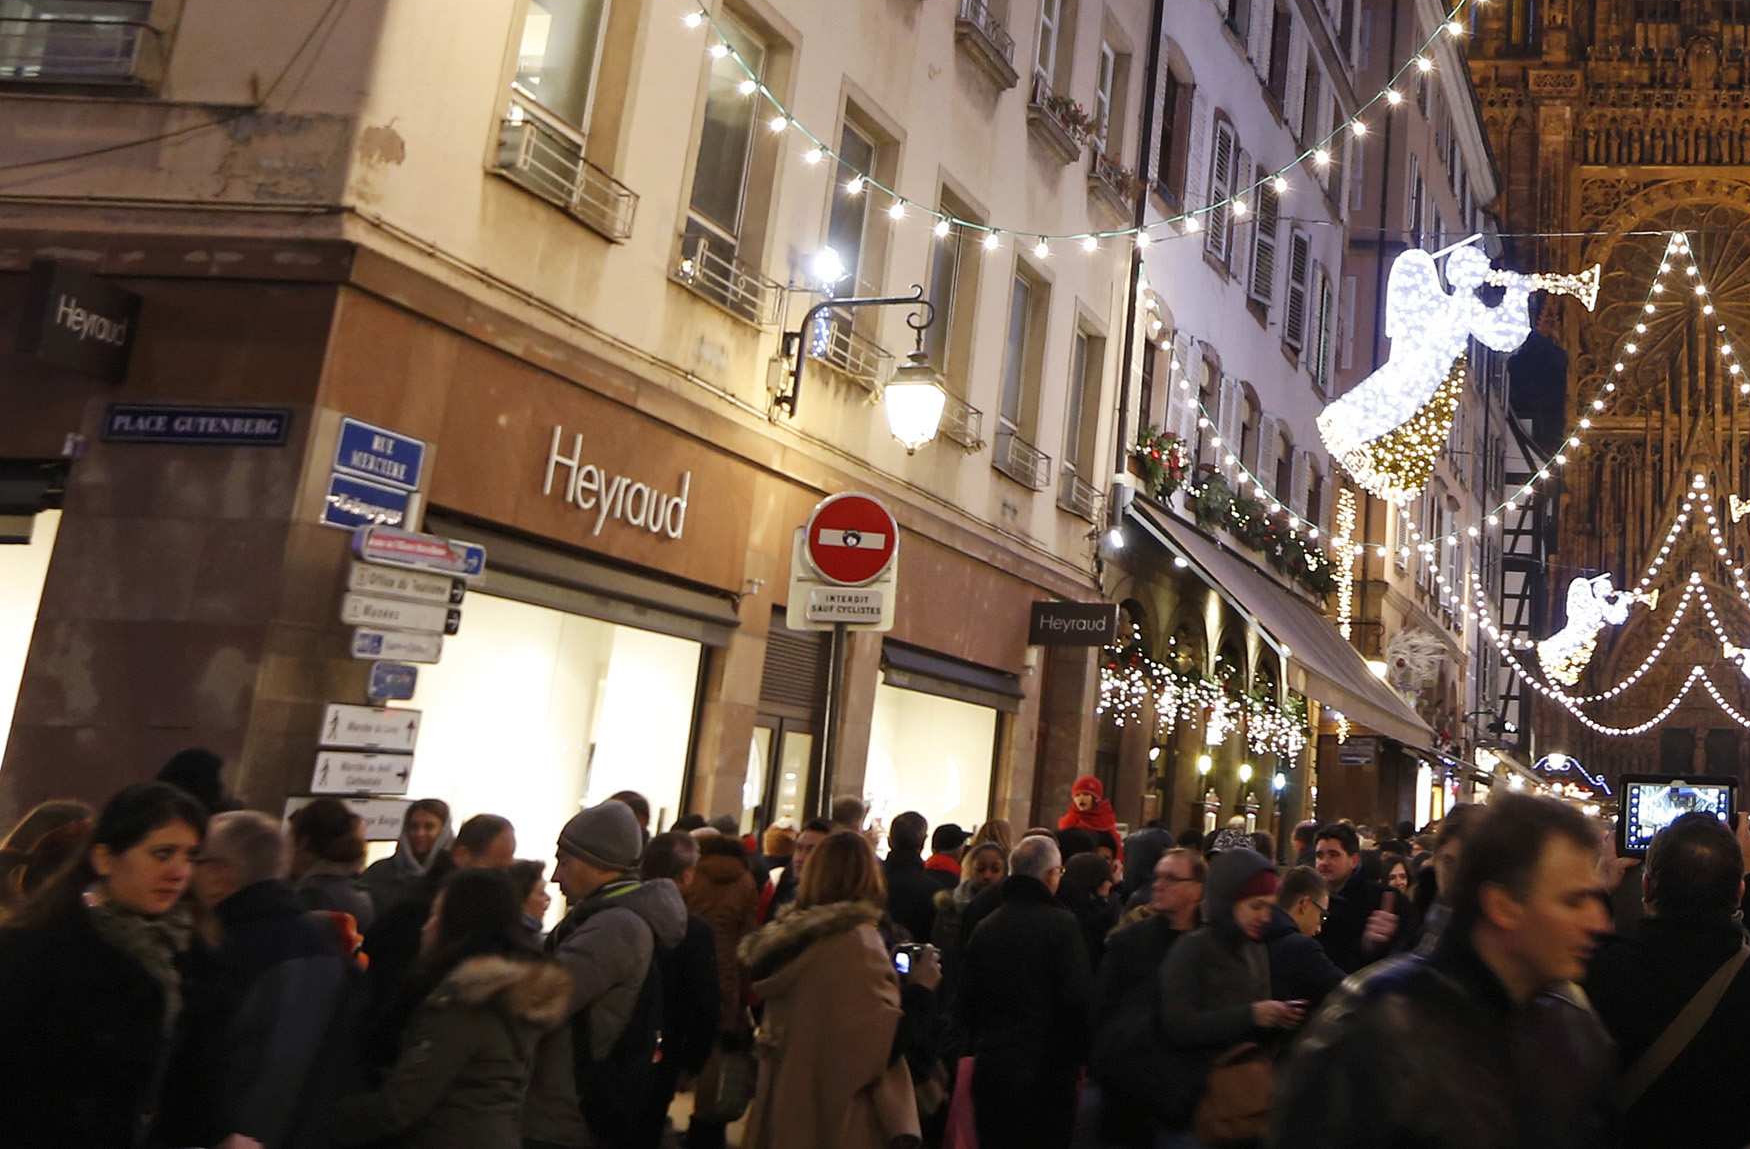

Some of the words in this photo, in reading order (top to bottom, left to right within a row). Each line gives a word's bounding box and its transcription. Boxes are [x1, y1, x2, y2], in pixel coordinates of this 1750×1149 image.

[56, 294, 127, 346] Heyraud
[112, 415, 168, 432] PLACE
[173, 416, 278, 435] GUTENBERG
[372, 434, 395, 455] RUE
[543, 424, 692, 541] Heyraud
[811, 603, 834, 614] SAUF
[836, 604, 881, 616] CYCLISTES
[825, 594, 870, 605] INTERDIT
[1039, 613, 1107, 633] Heyraud
